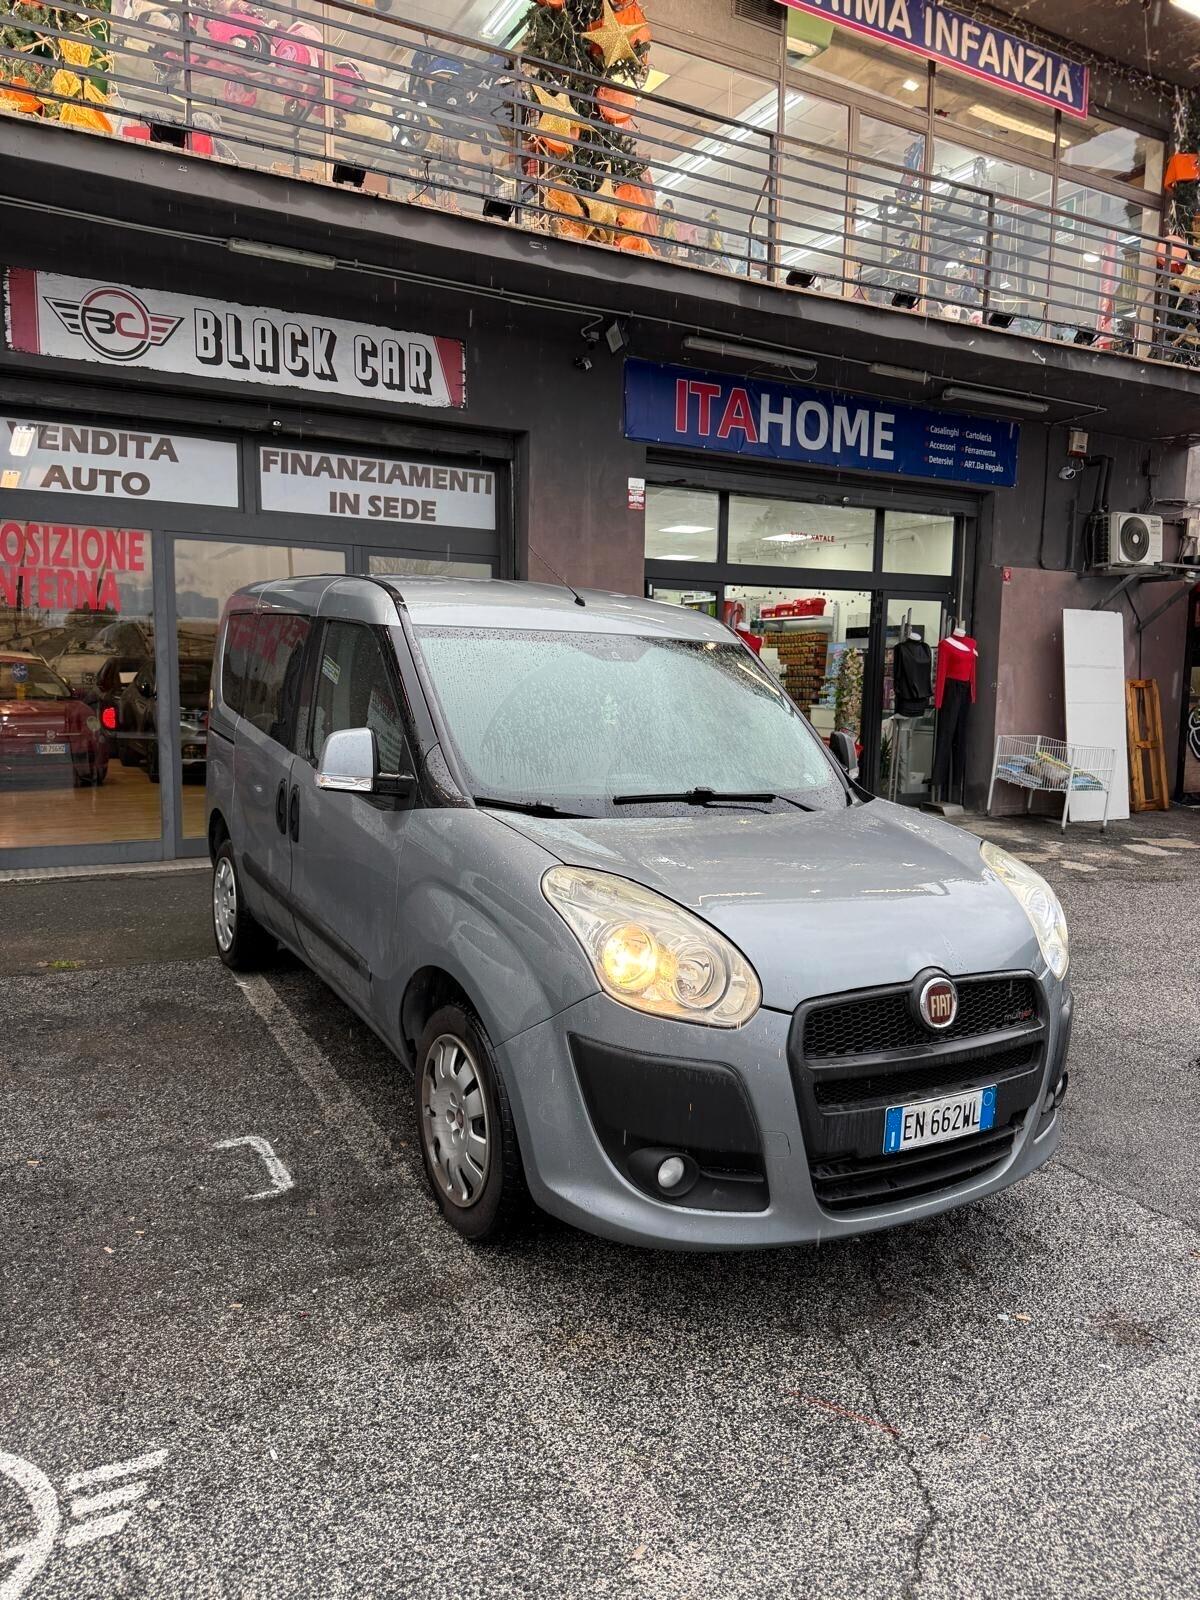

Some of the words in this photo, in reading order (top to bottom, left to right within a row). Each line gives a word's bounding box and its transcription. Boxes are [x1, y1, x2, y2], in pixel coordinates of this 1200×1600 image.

[925, 7, 1073, 103] INFANZIA
[194, 308, 338, 382] BLACK
[353, 334, 433, 395] CAR
[675, 378, 895, 461] ITAHOME
[930, 425, 959, 438] Casalinghi
[929, 440, 956, 452] Accessori
[965, 430, 992, 443] Cartoleria
[928, 455, 953, 466] Detersivi
[964, 445, 996, 458] Ferramenta
[40, 464, 150, 496] AUTO
[262, 450, 492, 495] FINANZIAMENTI
[984, 462, 1004, 473] Regalo
[329, 491, 360, 515] IN
[367, 495, 436, 522] SEDE
[930, 993, 951, 1018] FIAT
[903, 1111, 926, 1141] EN
[930, 1099, 980, 1136] 662WL
